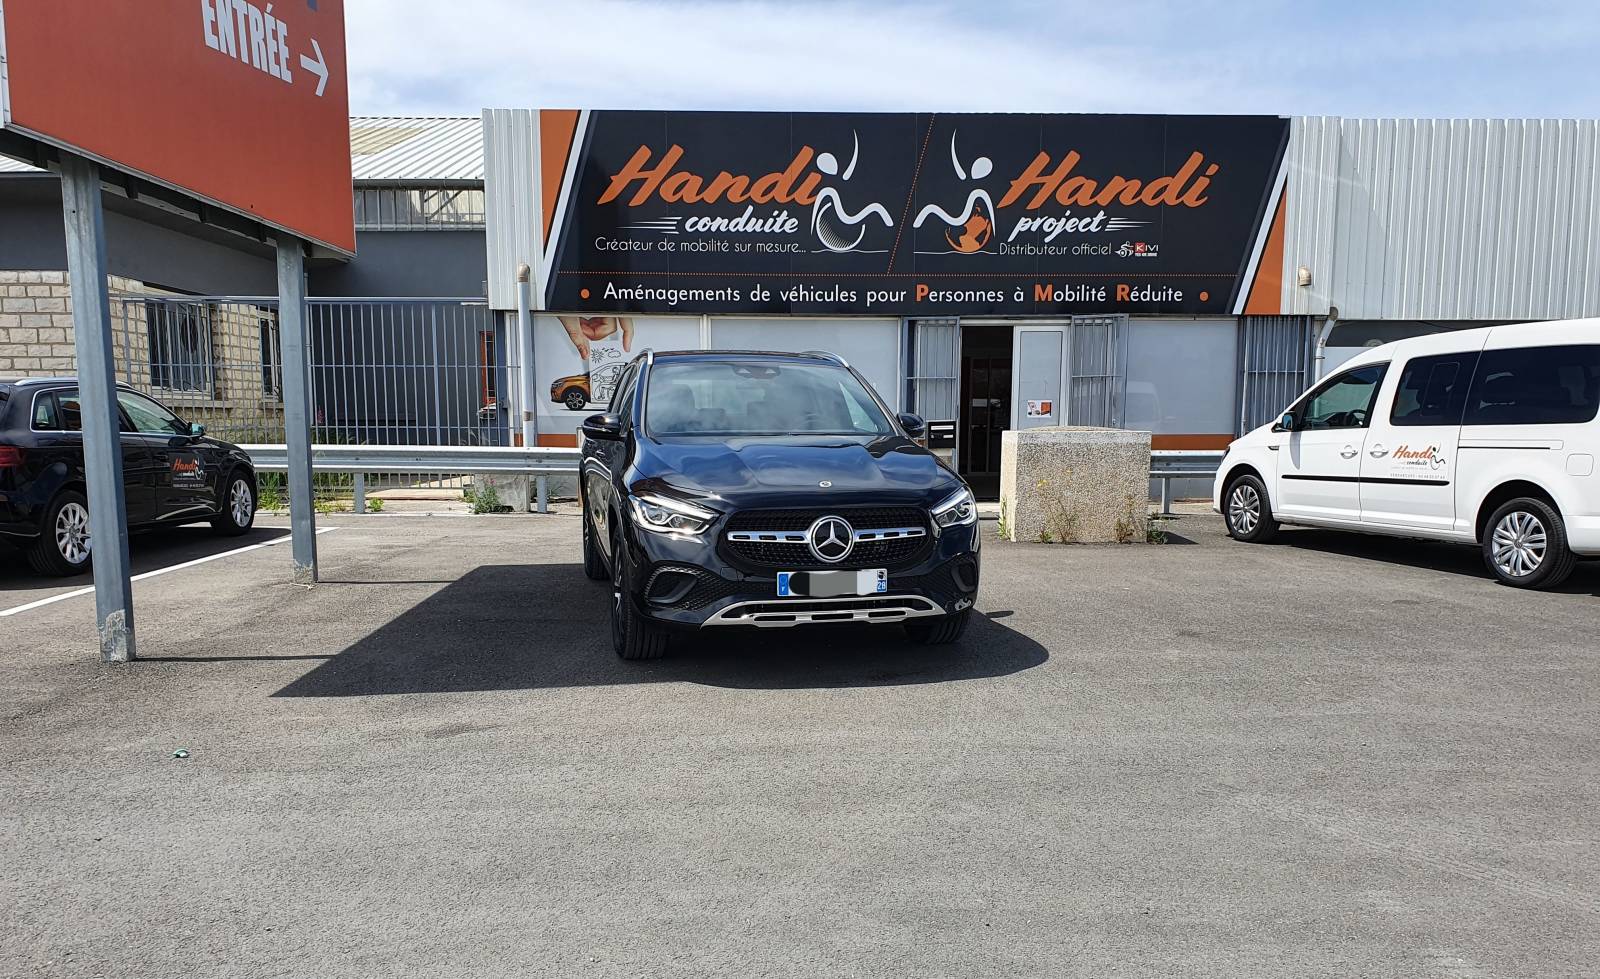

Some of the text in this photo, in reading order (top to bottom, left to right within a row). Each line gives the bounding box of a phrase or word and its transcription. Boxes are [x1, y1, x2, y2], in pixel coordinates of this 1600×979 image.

[201, 0, 292, 84] ENTRÉE
[597, 144, 822, 207] Handi
[997, 150, 1220, 210] Handi
[685, 205, 799, 233] conduite
[1007, 210, 1107, 243] project
[595, 236, 806, 253] Créateur de mobilité sur mesure...
[999, 242, 1112, 256] Distributeur officiel
[1135, 243, 1159, 253] KIVI
[603, 281, 1183, 308] Aménagements de véhicules pour Personnes à Mobilité Réduite
[1392, 445, 1432, 459] Handi
